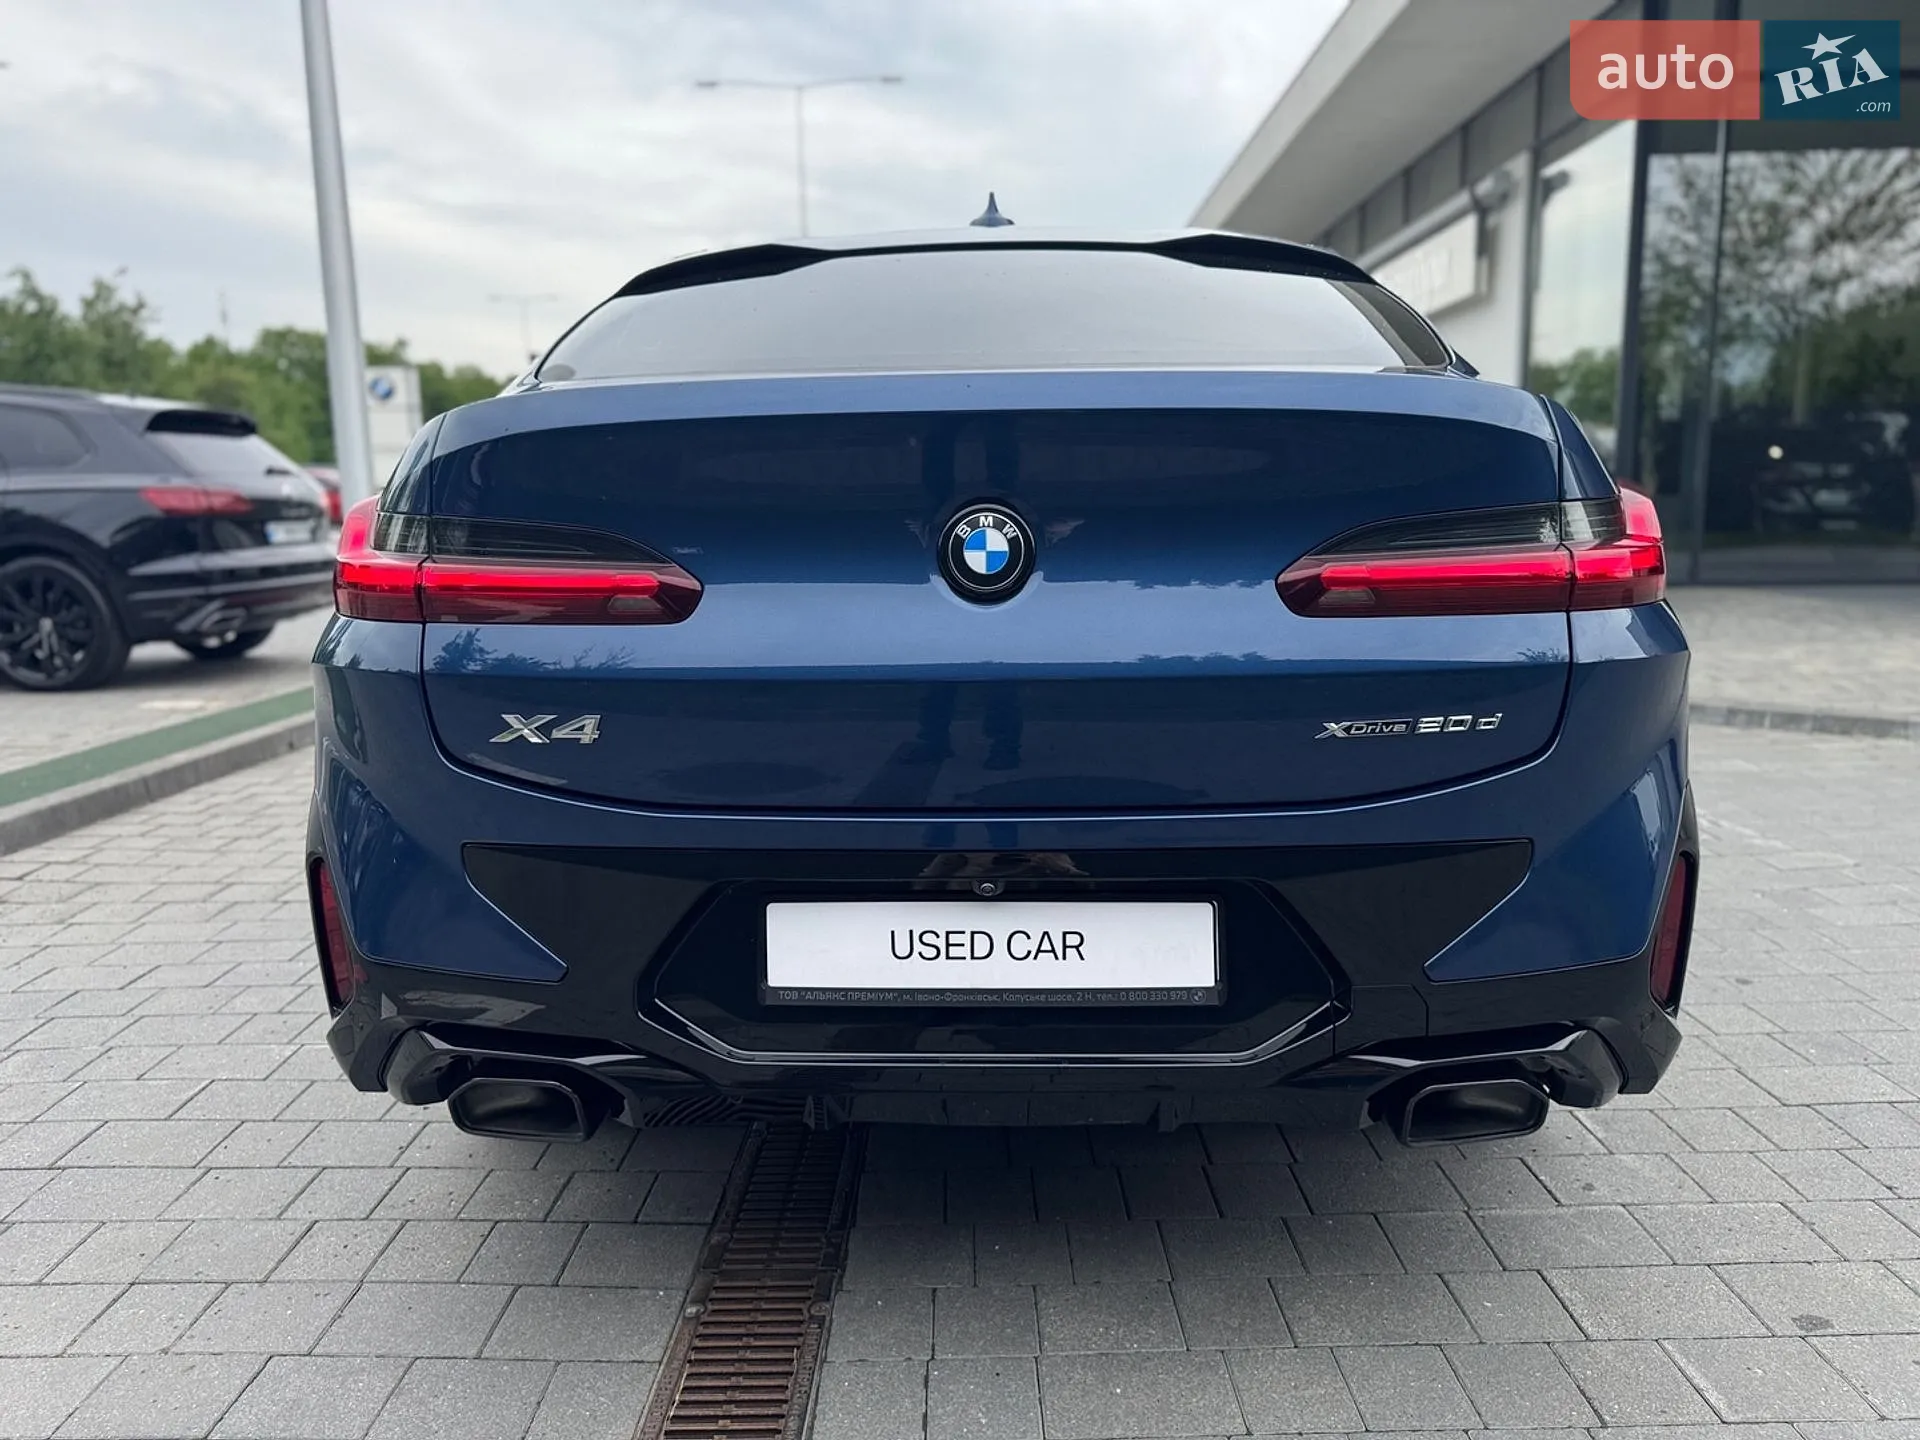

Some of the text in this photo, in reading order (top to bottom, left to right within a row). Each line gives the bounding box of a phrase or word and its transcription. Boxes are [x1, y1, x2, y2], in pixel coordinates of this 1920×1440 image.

[956, 515, 1017, 540] BMW
[488, 713, 601, 743] X4
[889, 929, 1086, 961] USED CAR
[778, 990, 798, 1000] ТОВ
[1128, 991, 1148, 1000] 800
